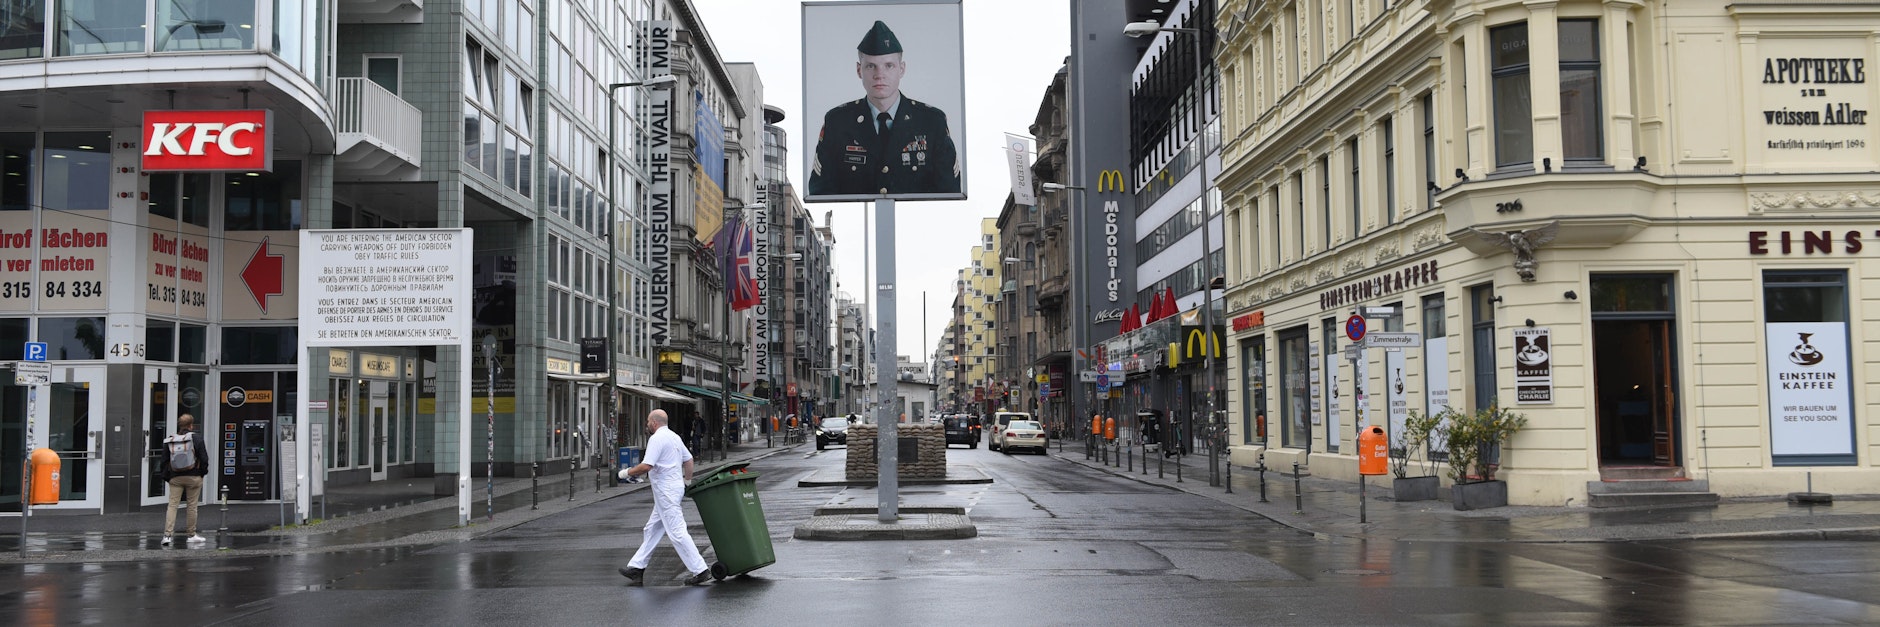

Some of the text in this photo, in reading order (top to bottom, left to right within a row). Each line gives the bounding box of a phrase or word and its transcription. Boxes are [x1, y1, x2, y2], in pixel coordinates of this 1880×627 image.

[652, 26, 668, 68] MUR
[1762, 58, 1865, 84] APOTHEKE
[1801, 89, 1826, 97] zum
[651, 100, 668, 148] WALL
[1763, 103, 1868, 126] weissen Adler
[144, 122, 257, 156] KFC
[1846, 140, 1866, 149] 1696
[651, 153, 668, 184] THE
[1496, 200, 1523, 214] 206
[1104, 201, 1121, 302] McDonald's
[155, 263, 163, 276] zu
[377, 265, 424, 274] АМЕРИКАНСКИЙ
[652, 194, 668, 339] MAUERMUSEUM
[756, 238, 767, 316] CHECKPOINT
[1320, 260, 1439, 310] EINSTEIN KAFFEE
[3, 281, 102, 299] 315 84 334
[149, 283, 205, 308] Tel. 315 84 334
[318, 329, 452, 338] SIE BETRETEN DEN AMERIKANISCHEN SEKTOR
[756, 319, 767, 339] AM
[29, 345, 42, 359] P
[110, 343, 130, 357] 45
[134, 344, 144, 357] 45
[756, 343, 767, 375] HAUS
[1779, 372, 1836, 380] EINSTEIN
[1783, 382, 1834, 390] KAFFEE
